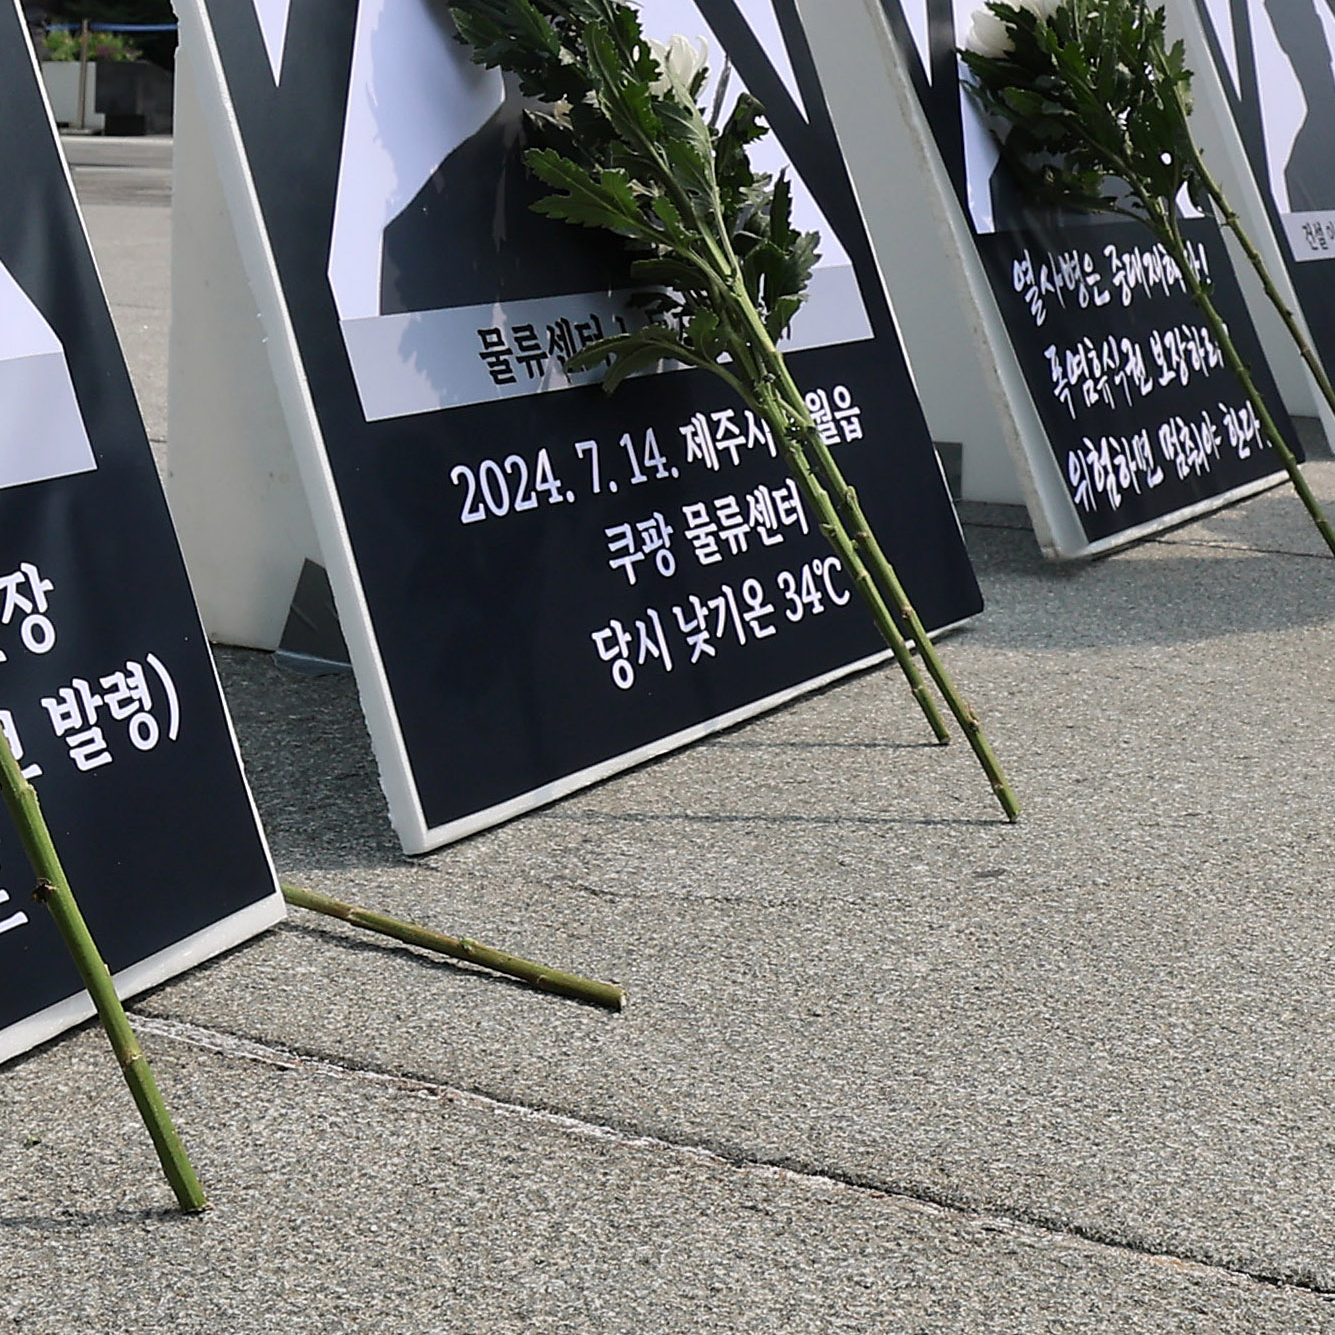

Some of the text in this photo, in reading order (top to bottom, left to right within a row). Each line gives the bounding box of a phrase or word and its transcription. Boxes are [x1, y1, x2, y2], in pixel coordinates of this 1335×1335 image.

[1012, 248, 1110, 326] 열사병은
[1150, 323, 1229, 386] 보장하라
[450, 448, 576, 524] 2024.
[574, 439, 618, 495] 7.
[620, 427, 680, 484] 14.
[679, 409, 777, 471] 제주시
[1068, 429, 1164, 512] 위험하면
[1159, 410, 1222, 480] 멈춰야
[605, 478, 809, 586] 쿠팡 물류센터
[0, 562, 57, 660] 장
[592, 607, 673, 690] 당시
[672, 578, 777, 663] 낮기온
[41, 652, 181, 773] 발령)
